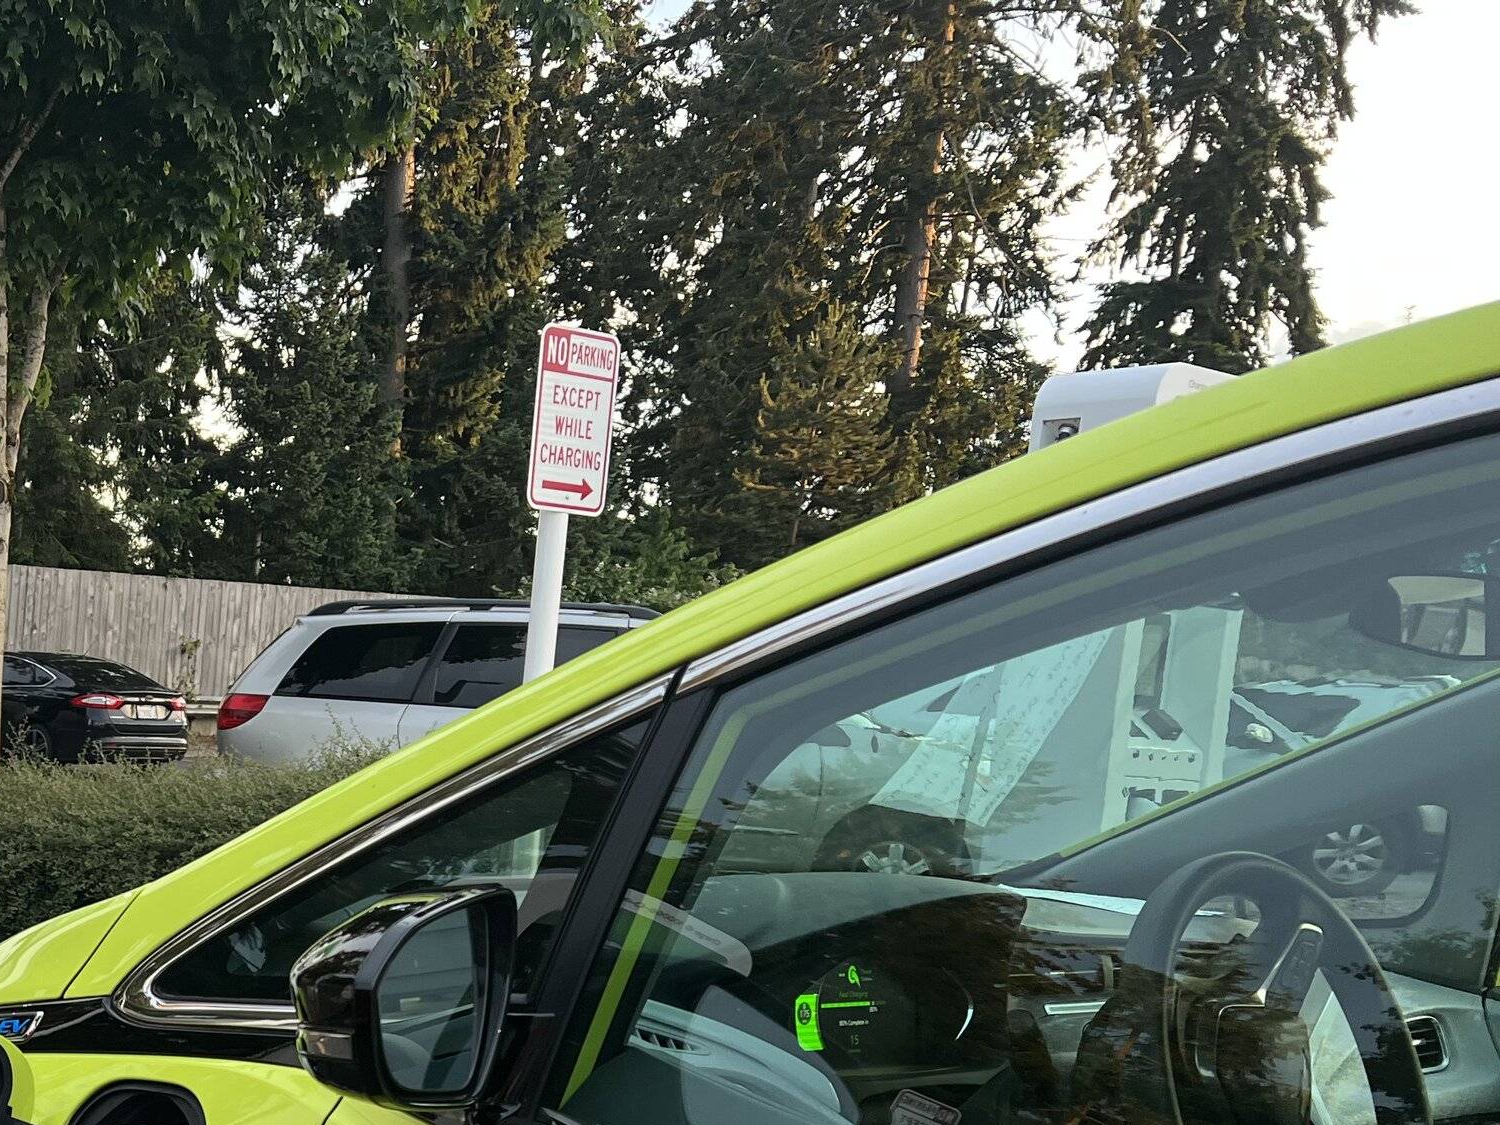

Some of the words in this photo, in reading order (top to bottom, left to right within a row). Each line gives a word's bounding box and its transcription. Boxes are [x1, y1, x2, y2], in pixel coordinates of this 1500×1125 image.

[546, 334, 568, 366] NO
[570, 342, 614, 371] PARKING
[553, 384, 602, 411] EXCEPT
[555, 415, 593, 440] WHILE
[540, 443, 601, 471] CHARGING
